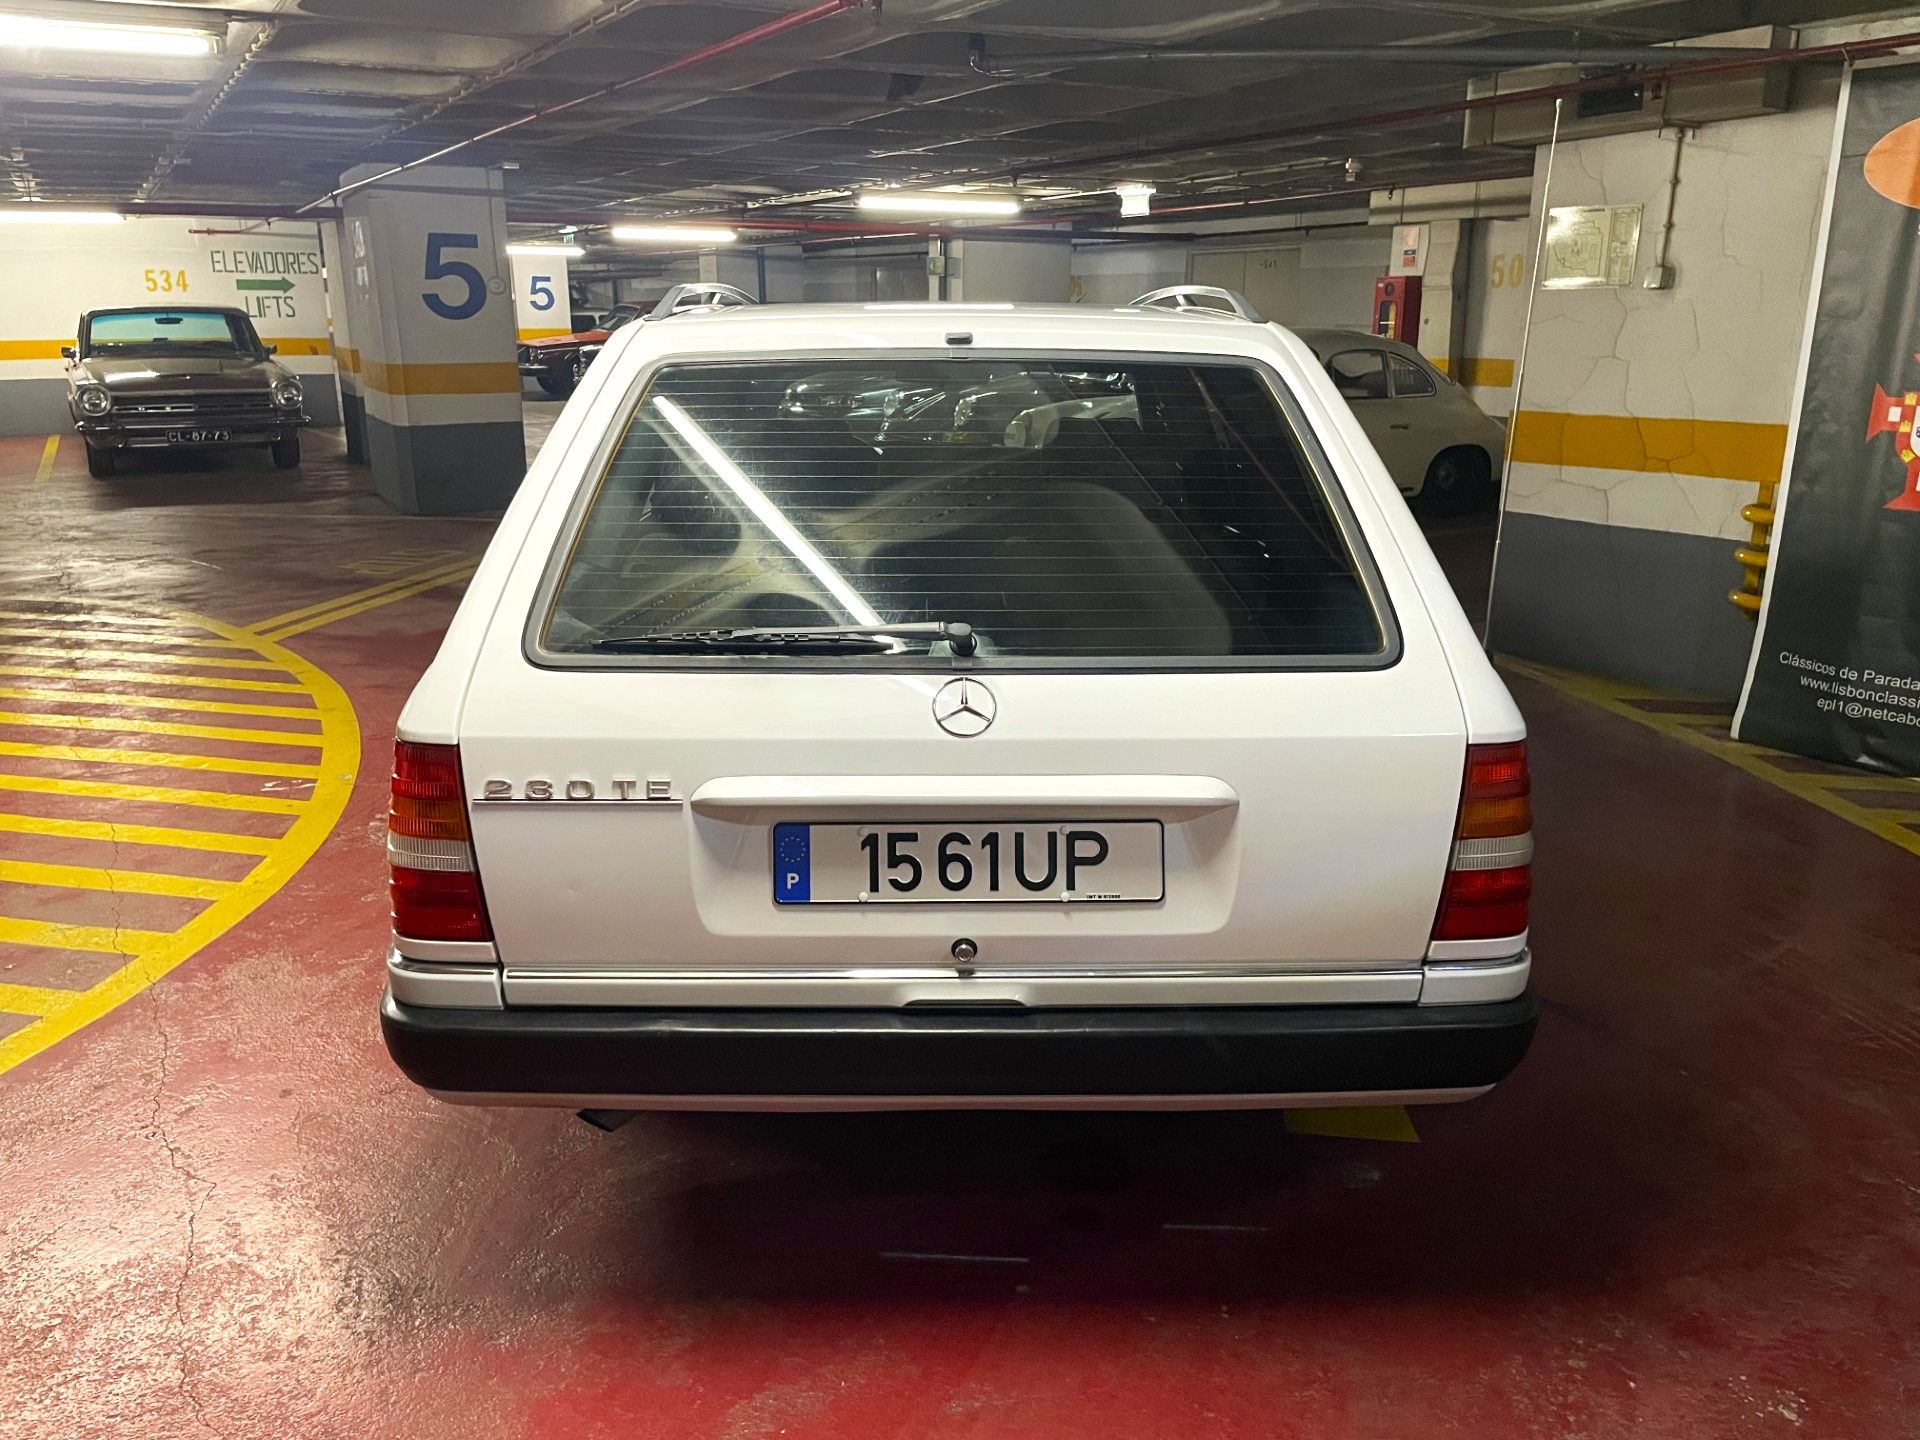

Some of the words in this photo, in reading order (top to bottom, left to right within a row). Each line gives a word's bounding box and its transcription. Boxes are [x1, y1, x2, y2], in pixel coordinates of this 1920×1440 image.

[210, 250, 319, 275] ELEVADORES
[144, 269, 189, 293] 534
[422, 232, 487, 320] 5
[529, 275, 555, 311] 5
[245, 296, 296, 318] LIFTS
[1779, 651, 1836, 676] Clássicos
[1839, 667, 1858, 680] de
[1863, 670, 1920, 691] Parada
[786, 872, 800, 890] P
